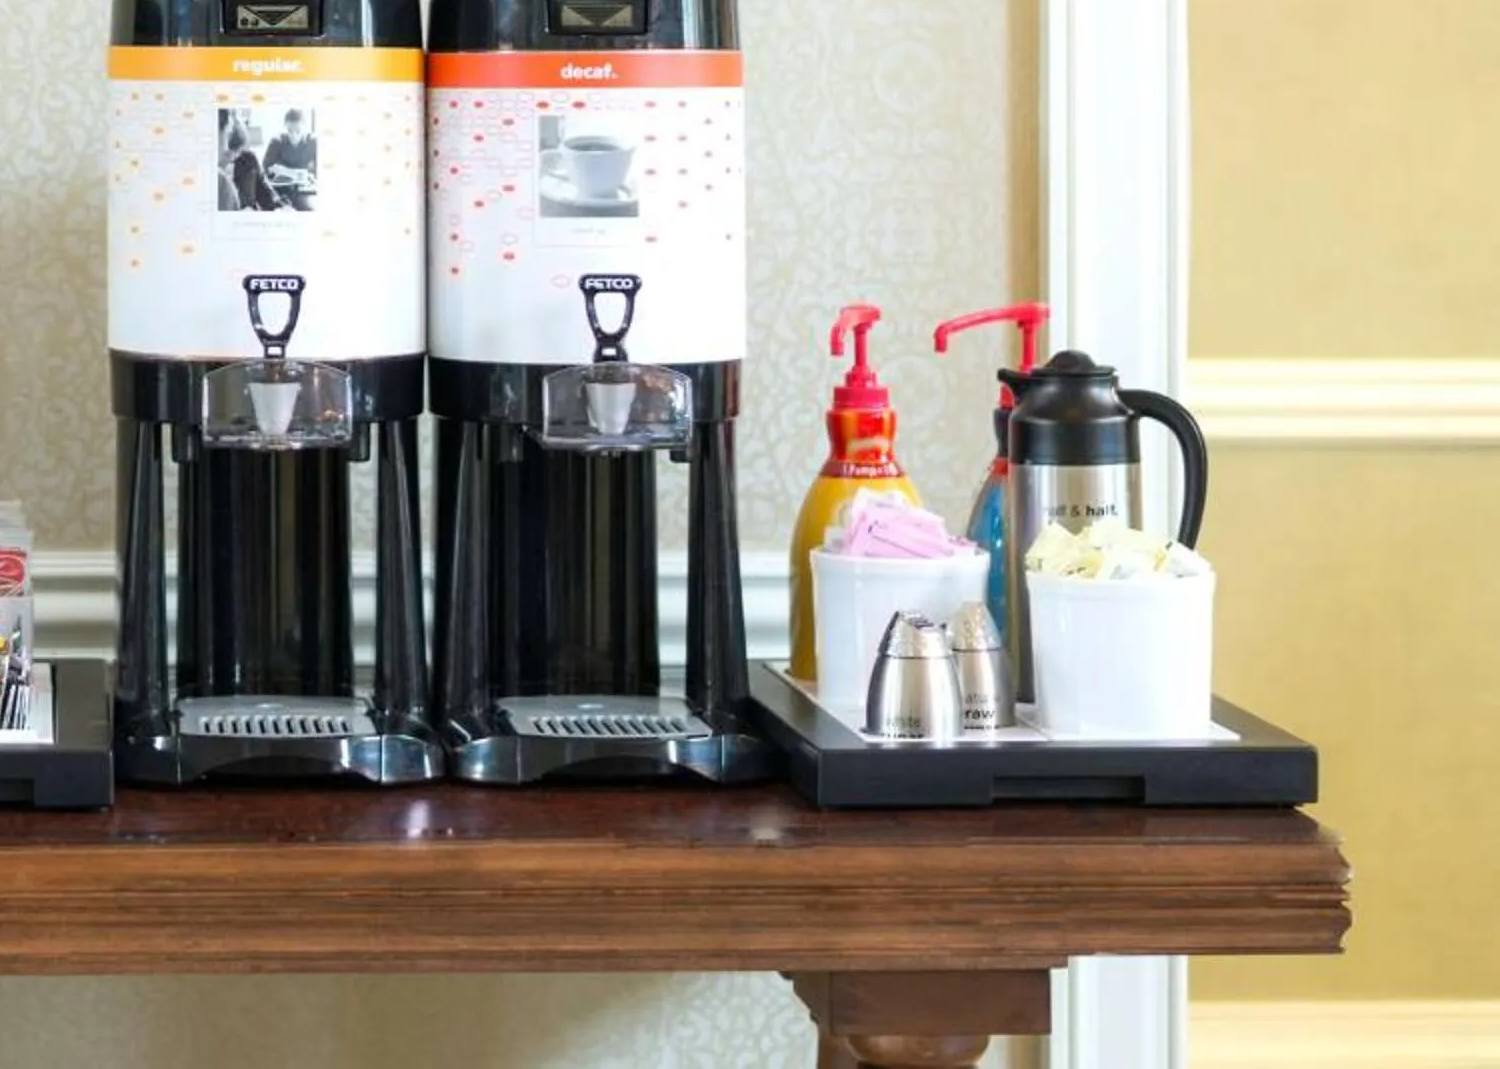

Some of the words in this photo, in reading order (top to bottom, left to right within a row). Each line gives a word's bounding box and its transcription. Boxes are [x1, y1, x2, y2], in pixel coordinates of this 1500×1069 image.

[249, 278, 299, 290] FETCO
[585, 278, 634, 290] FETCO
[964, 710, 996, 720] raw
